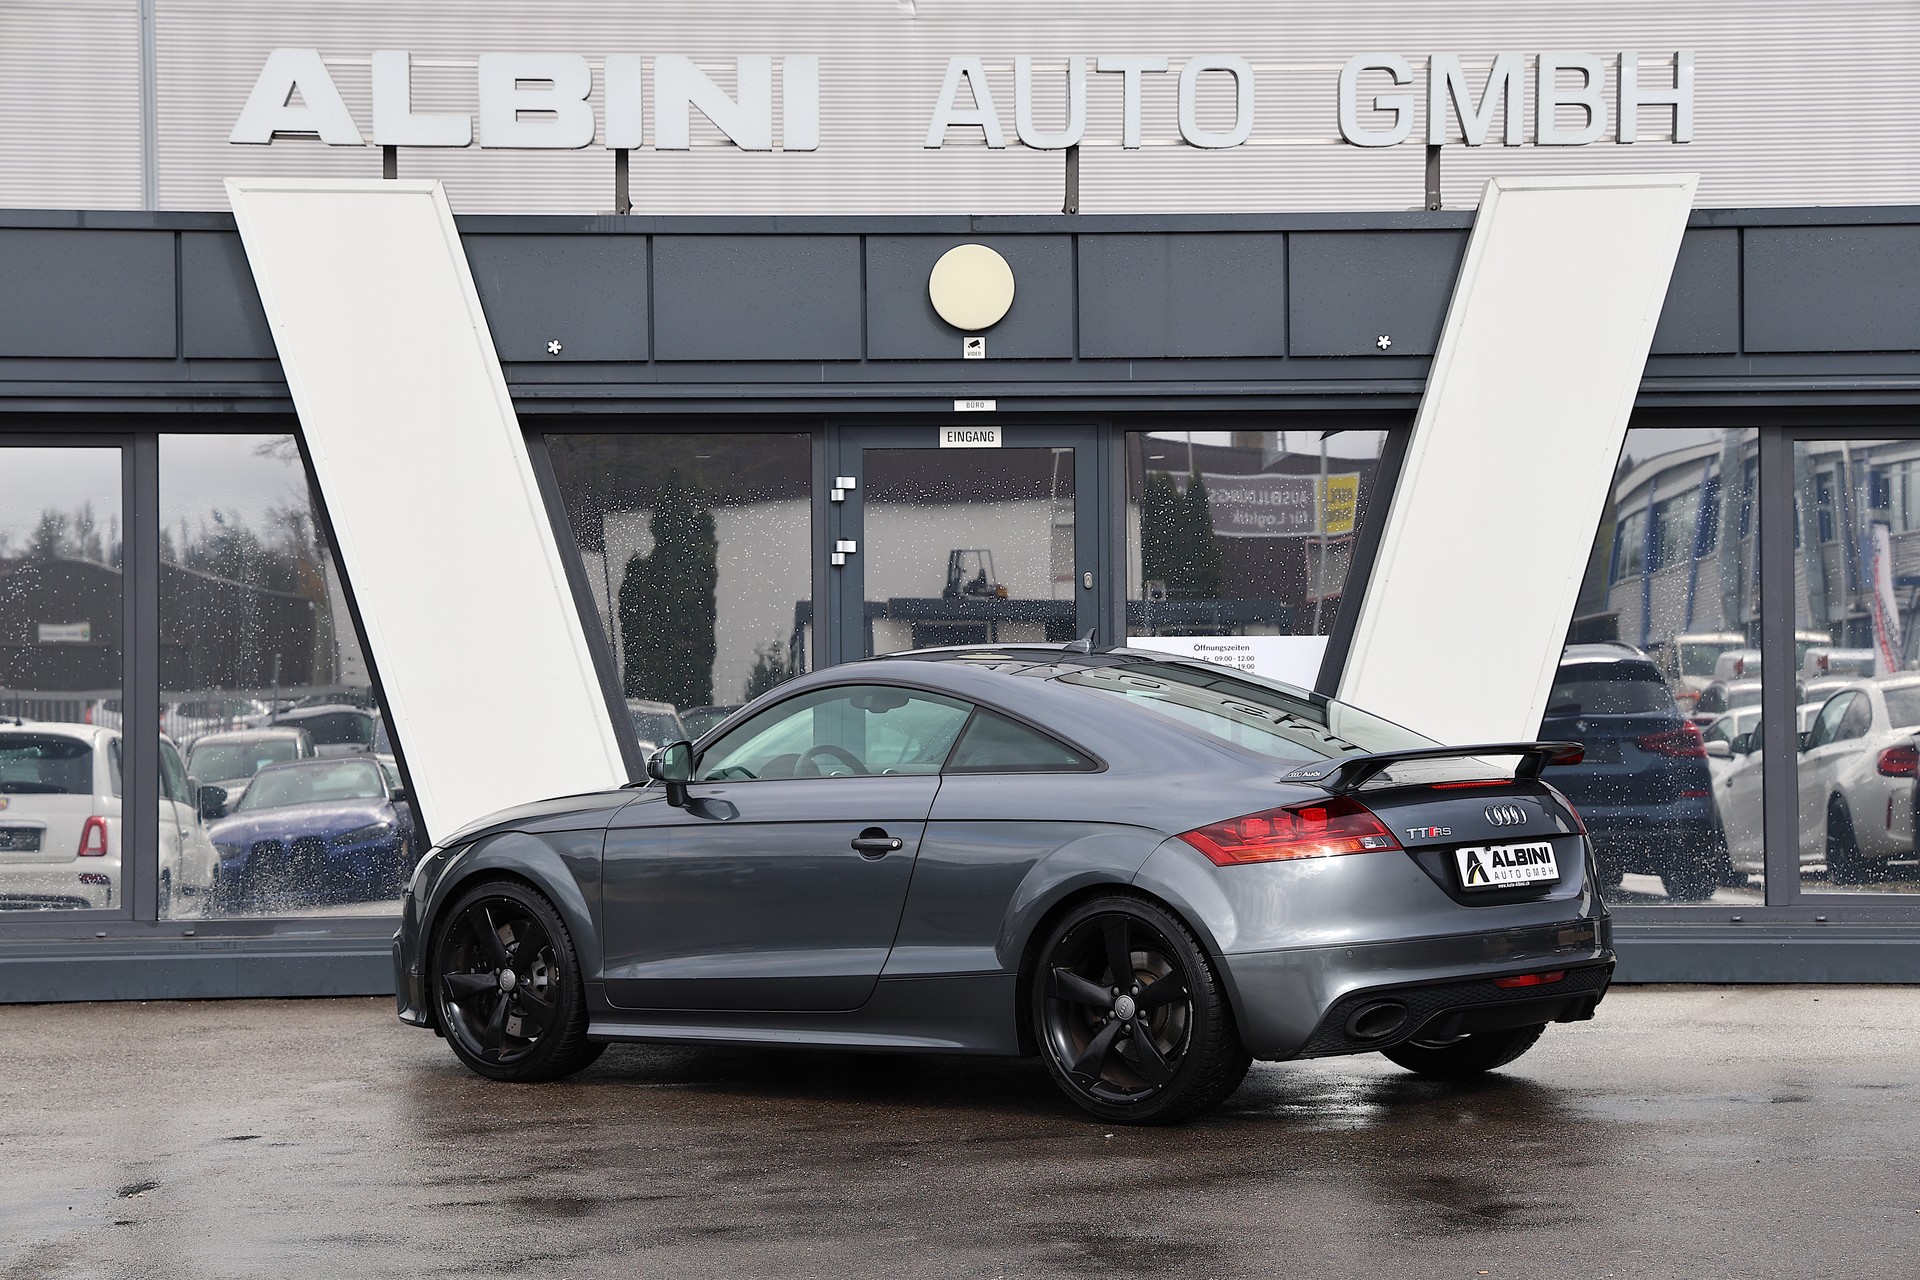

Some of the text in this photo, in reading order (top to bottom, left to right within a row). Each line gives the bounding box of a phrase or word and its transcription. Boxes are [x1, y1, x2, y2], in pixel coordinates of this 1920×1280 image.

[229, 47, 1696, 152] ALBINI AUTO GMBH
[966, 400, 985, 409] BÜRO
[947, 430, 996, 443] EINGANG
[1193, 643, 1250, 652] Öffnungszeiten
[1492, 847, 1551, 868] ALBINI
[1494, 866, 1555, 881] AUTO GMBH
